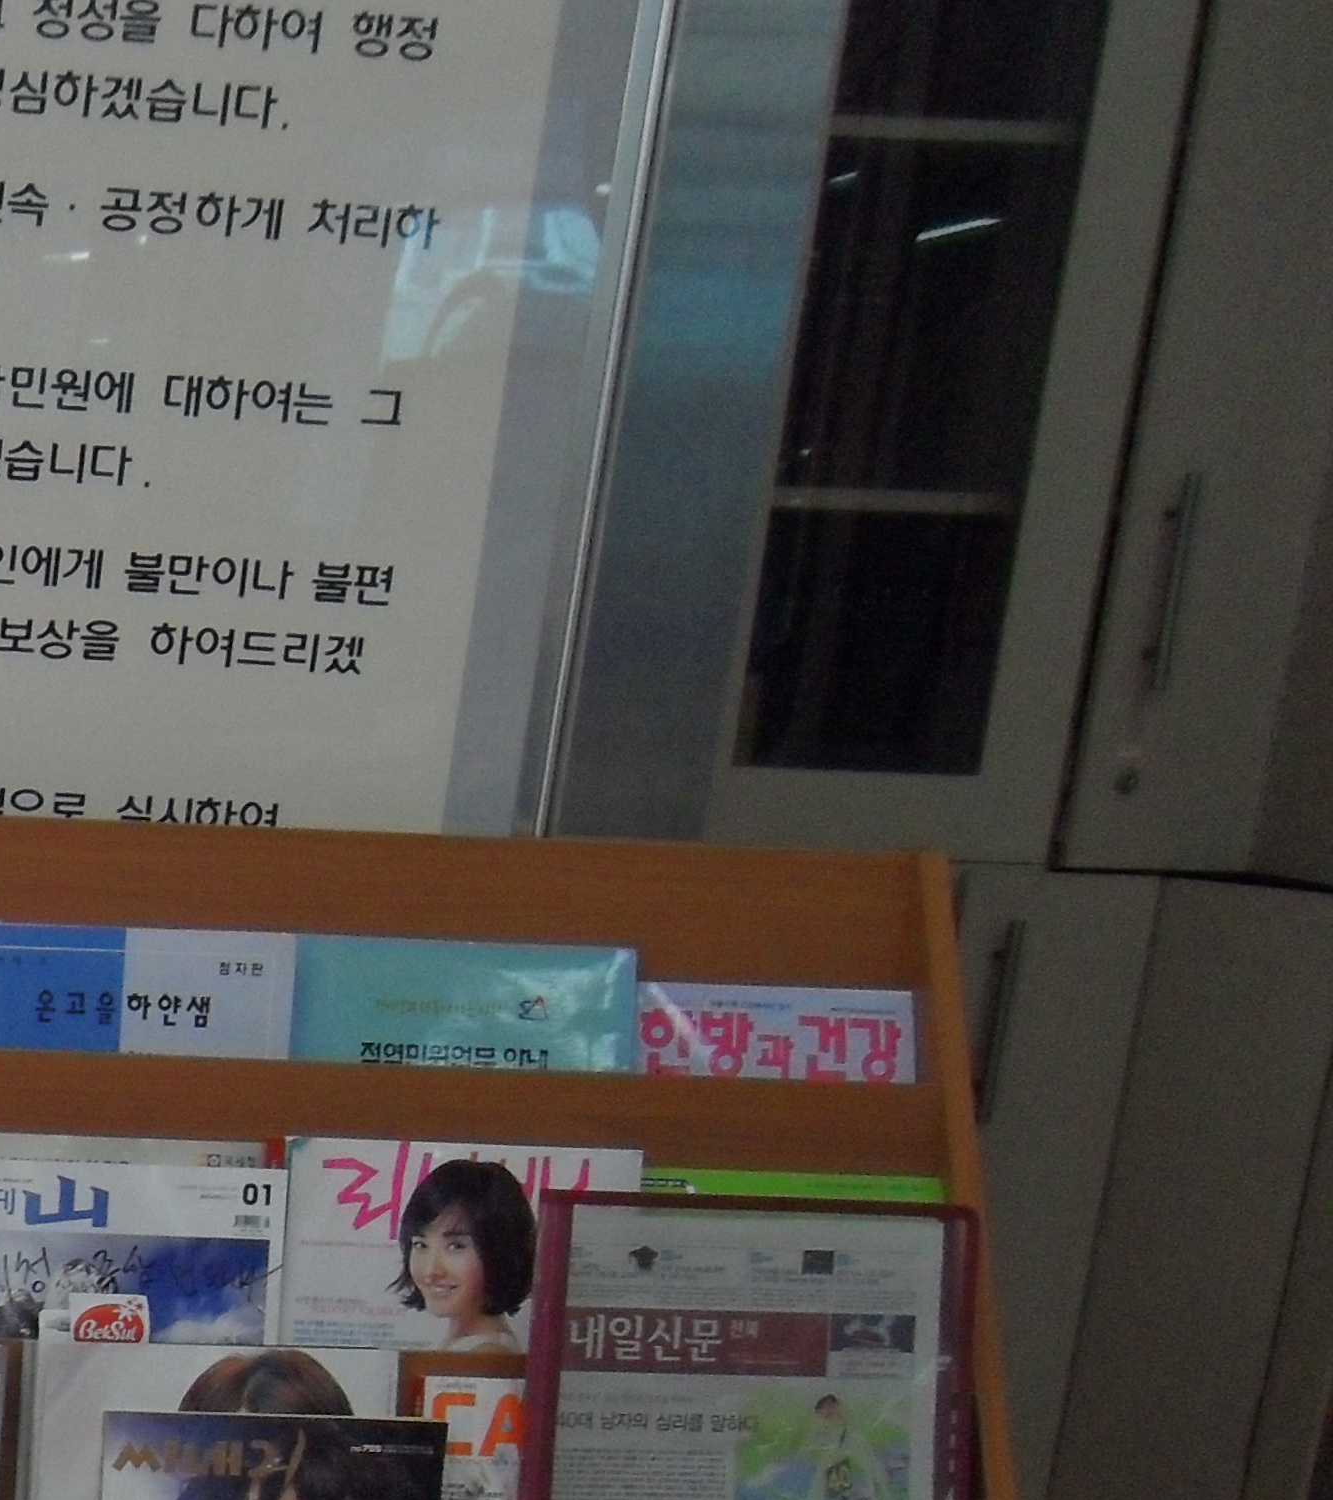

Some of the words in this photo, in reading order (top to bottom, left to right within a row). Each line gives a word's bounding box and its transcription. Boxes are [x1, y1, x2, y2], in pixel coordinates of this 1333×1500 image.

[191, 5, 323, 54] 다하여
[353, 9, 440, 63] 행정
[308, 198, 442, 252] 처리하
[164, 372, 334, 428] 대하여는
[359, 387, 405, 429] 그
[123, 549, 294, 602] 불만이나
[312, 561, 395, 608] 불편
[150, 622, 366, 677] 하여드리겠
[22, 1174, 110, 1229] 山
[241, 1182, 272, 1207] 01
[569, 1313, 724, 1363] 내일신문
